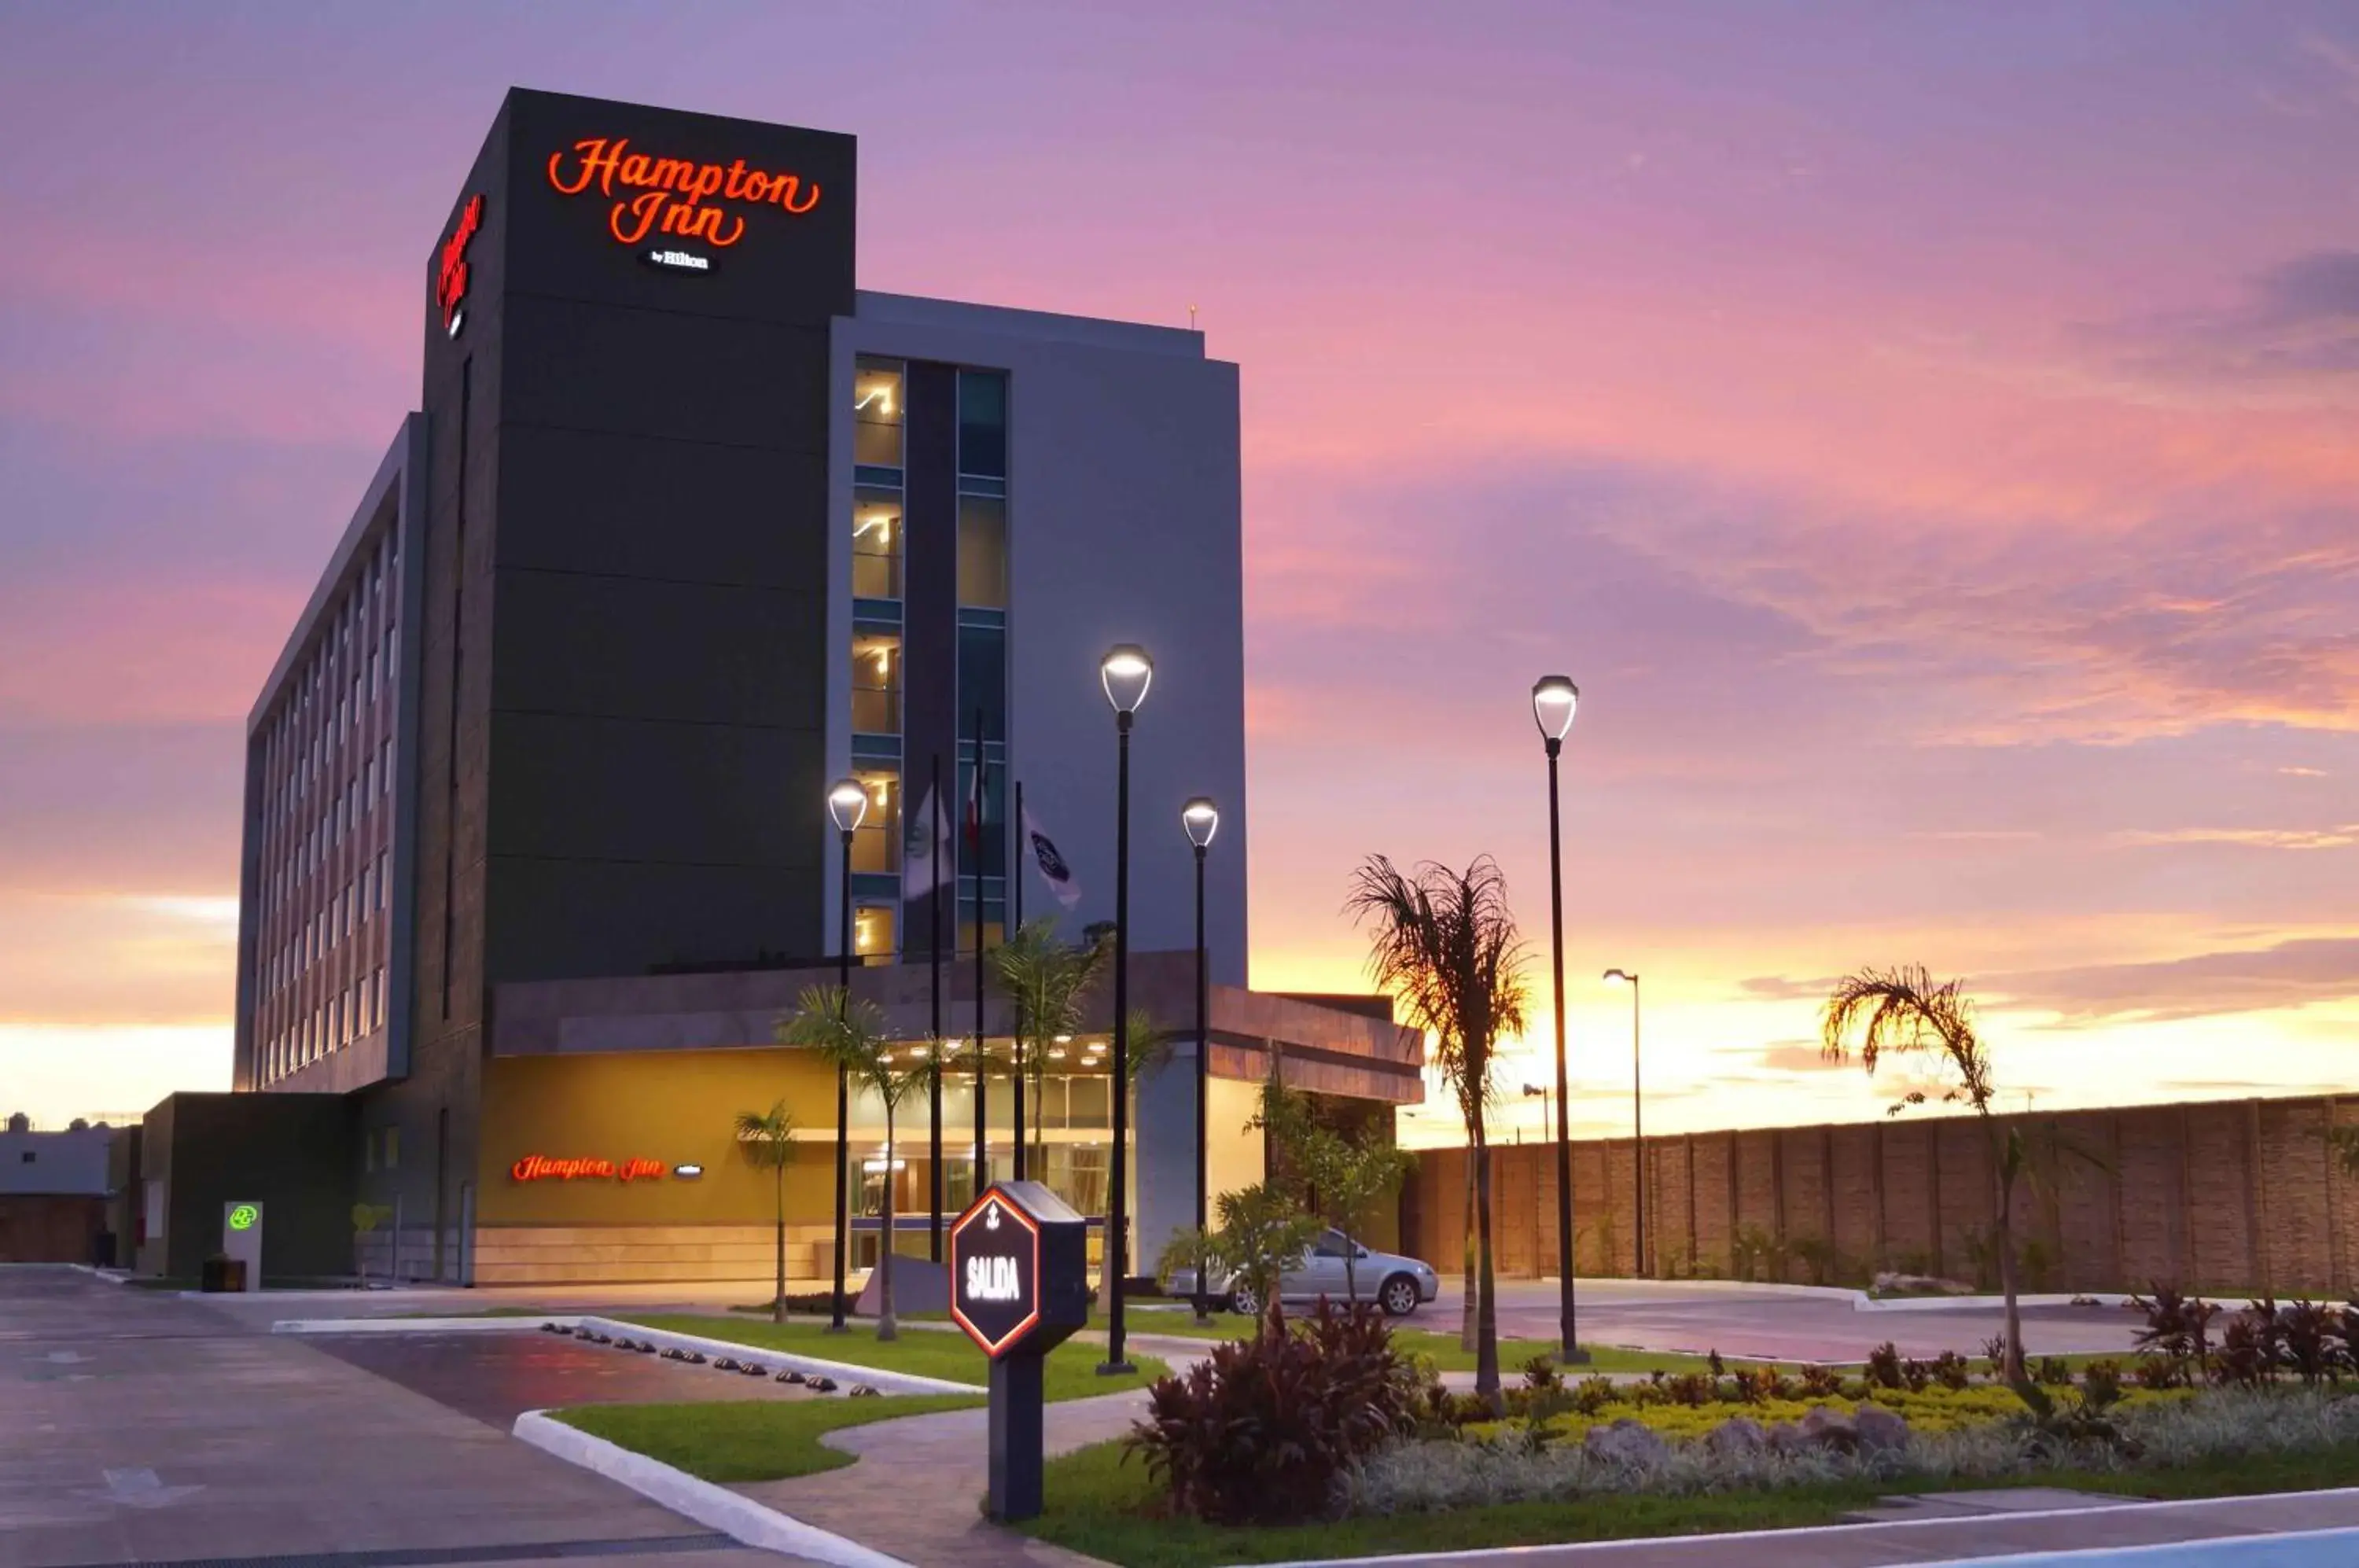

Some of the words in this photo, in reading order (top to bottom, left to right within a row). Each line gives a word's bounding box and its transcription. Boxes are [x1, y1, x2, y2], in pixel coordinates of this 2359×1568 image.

[549, 138, 820, 213] Hampton
[611, 191, 745, 245] Inn
[664, 251, 708, 269] Hilton
[513, 1155, 616, 1180] Hampton
[620, 1158, 666, 1182] Inn
[967, 1257, 1020, 1301] SALIDA
